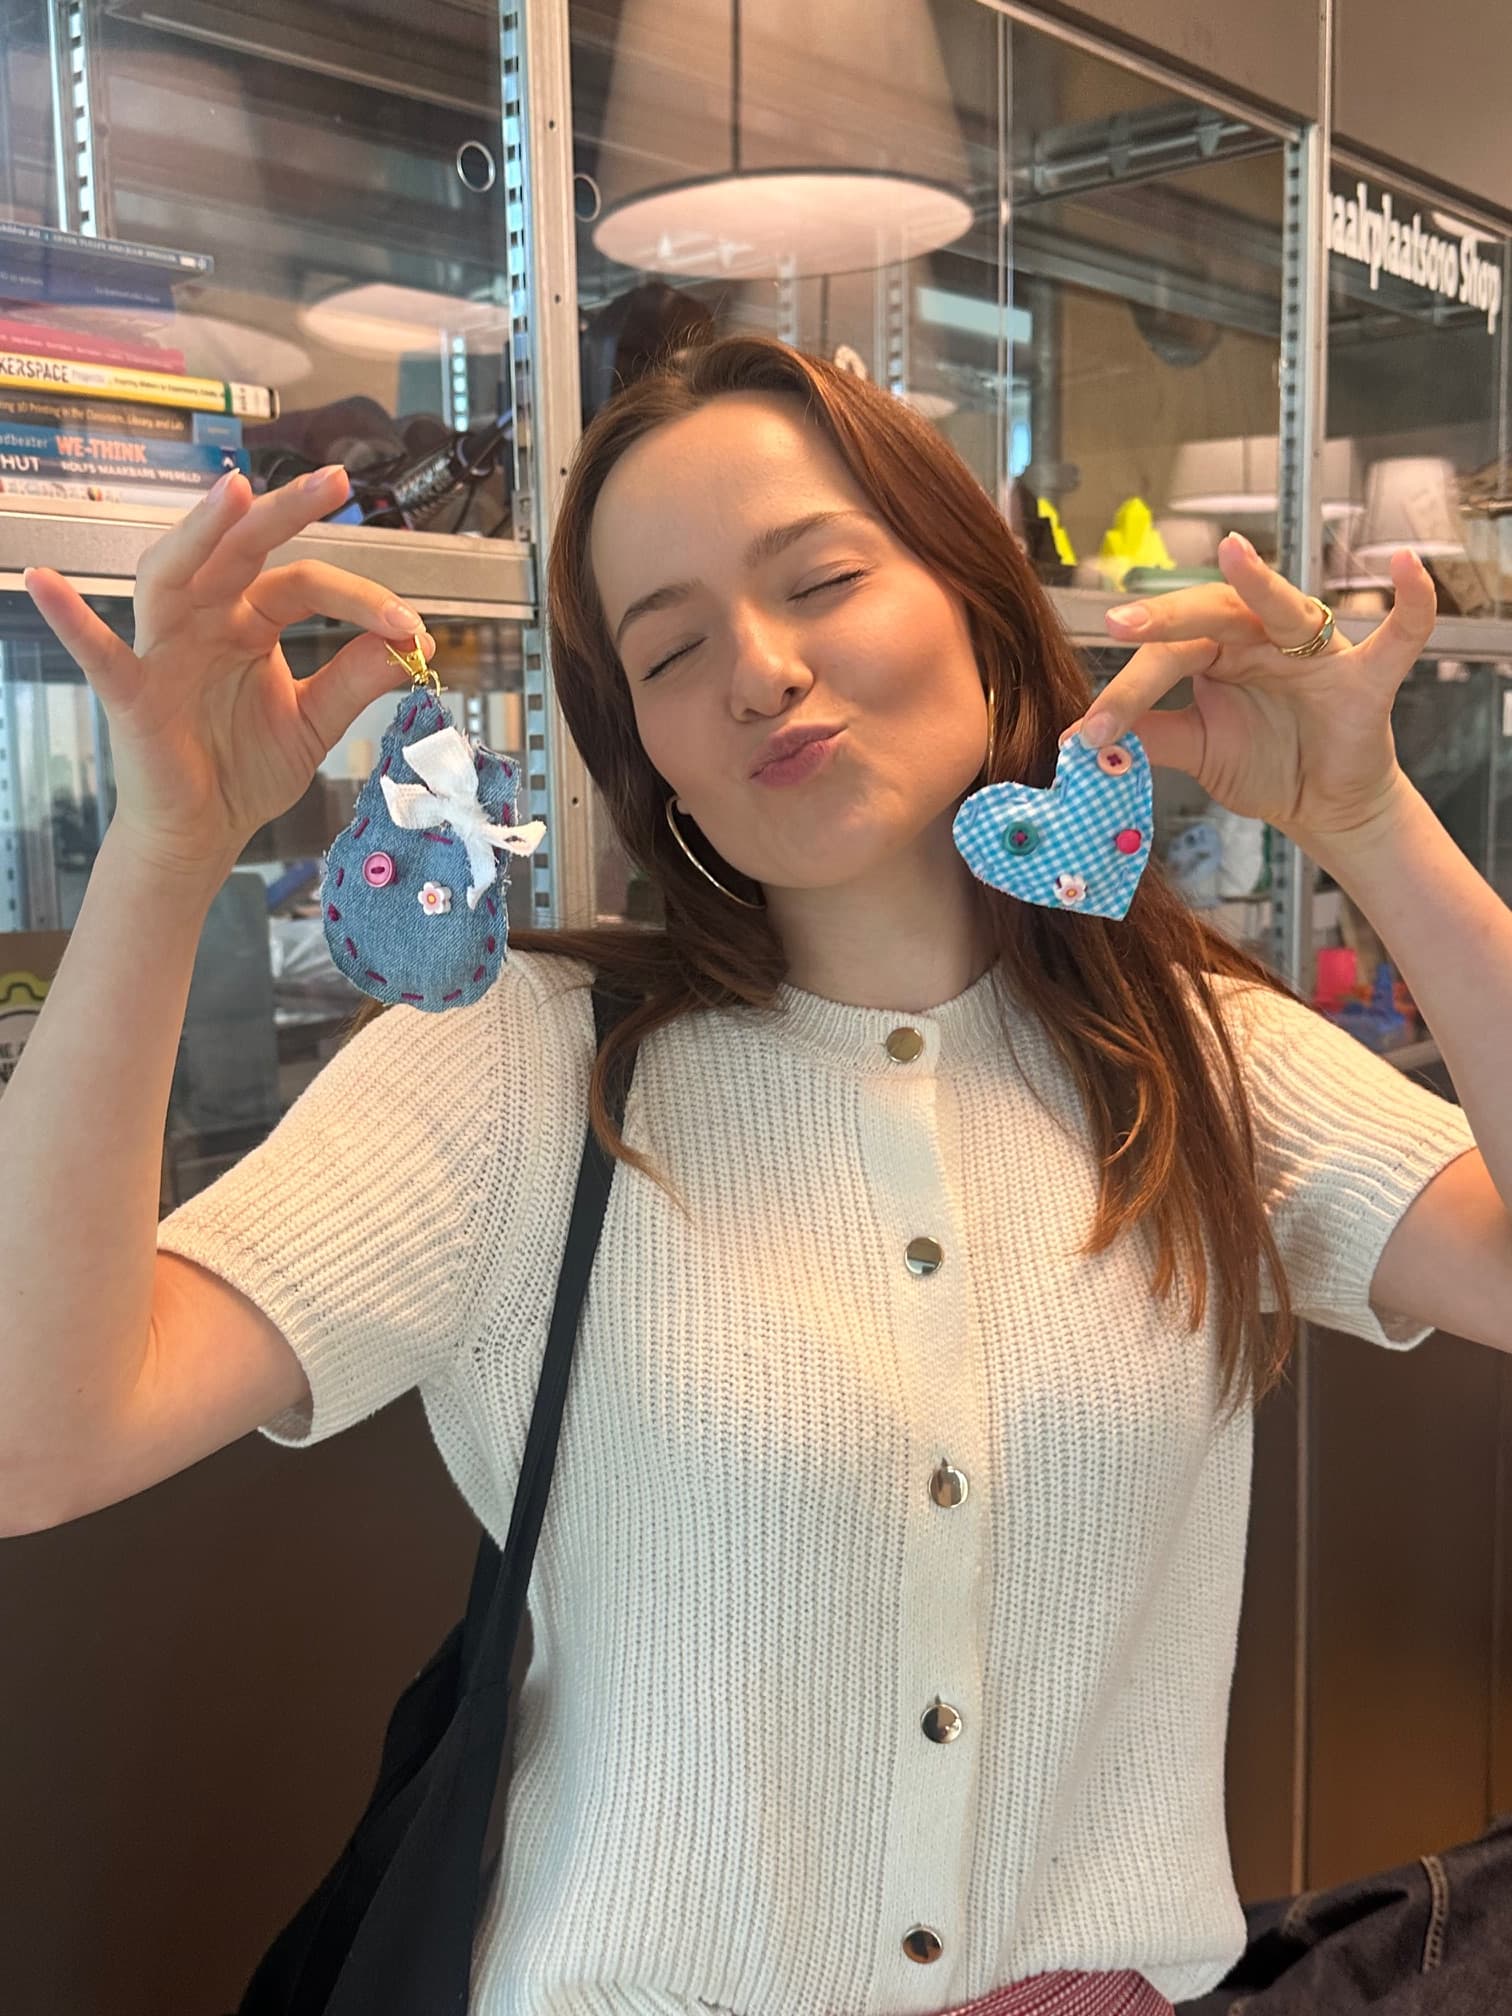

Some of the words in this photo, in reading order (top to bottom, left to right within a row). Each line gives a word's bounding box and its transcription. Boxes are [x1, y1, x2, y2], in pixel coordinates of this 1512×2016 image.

[1459, 235, 1501, 335] Shop
[0, 453, 40, 472] HUT
[56, 434, 148, 464] WE-THINK
